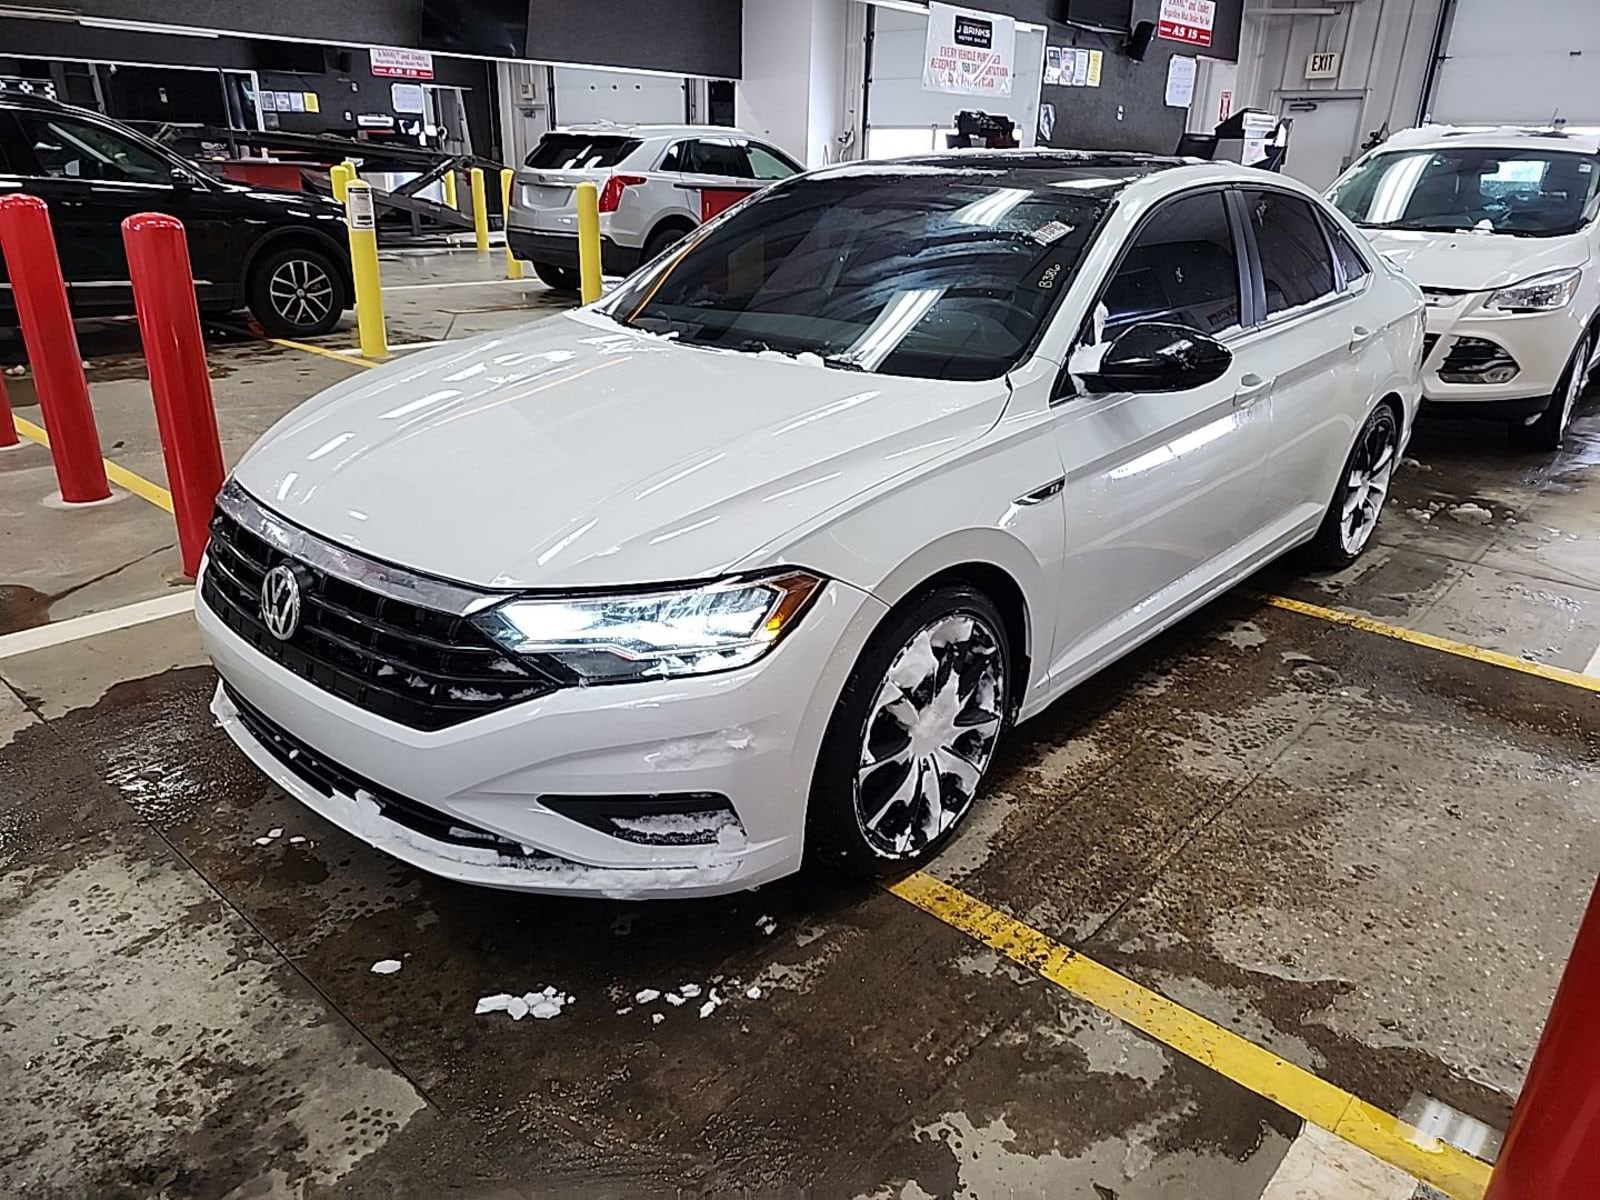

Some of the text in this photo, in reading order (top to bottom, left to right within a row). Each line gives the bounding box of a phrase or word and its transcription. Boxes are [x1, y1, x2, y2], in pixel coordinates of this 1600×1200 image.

[956, 25, 990, 37] J BRINKS
[1172, 26, 1198, 39] AS IS
[940, 46, 956, 57] EVERY
[958, 49, 976, 61] VEHICLE
[931, 58, 956, 70] RECEIVES
[1311, 54, 1336, 72] EXIT
[1038, 263, 1061, 289] B386
